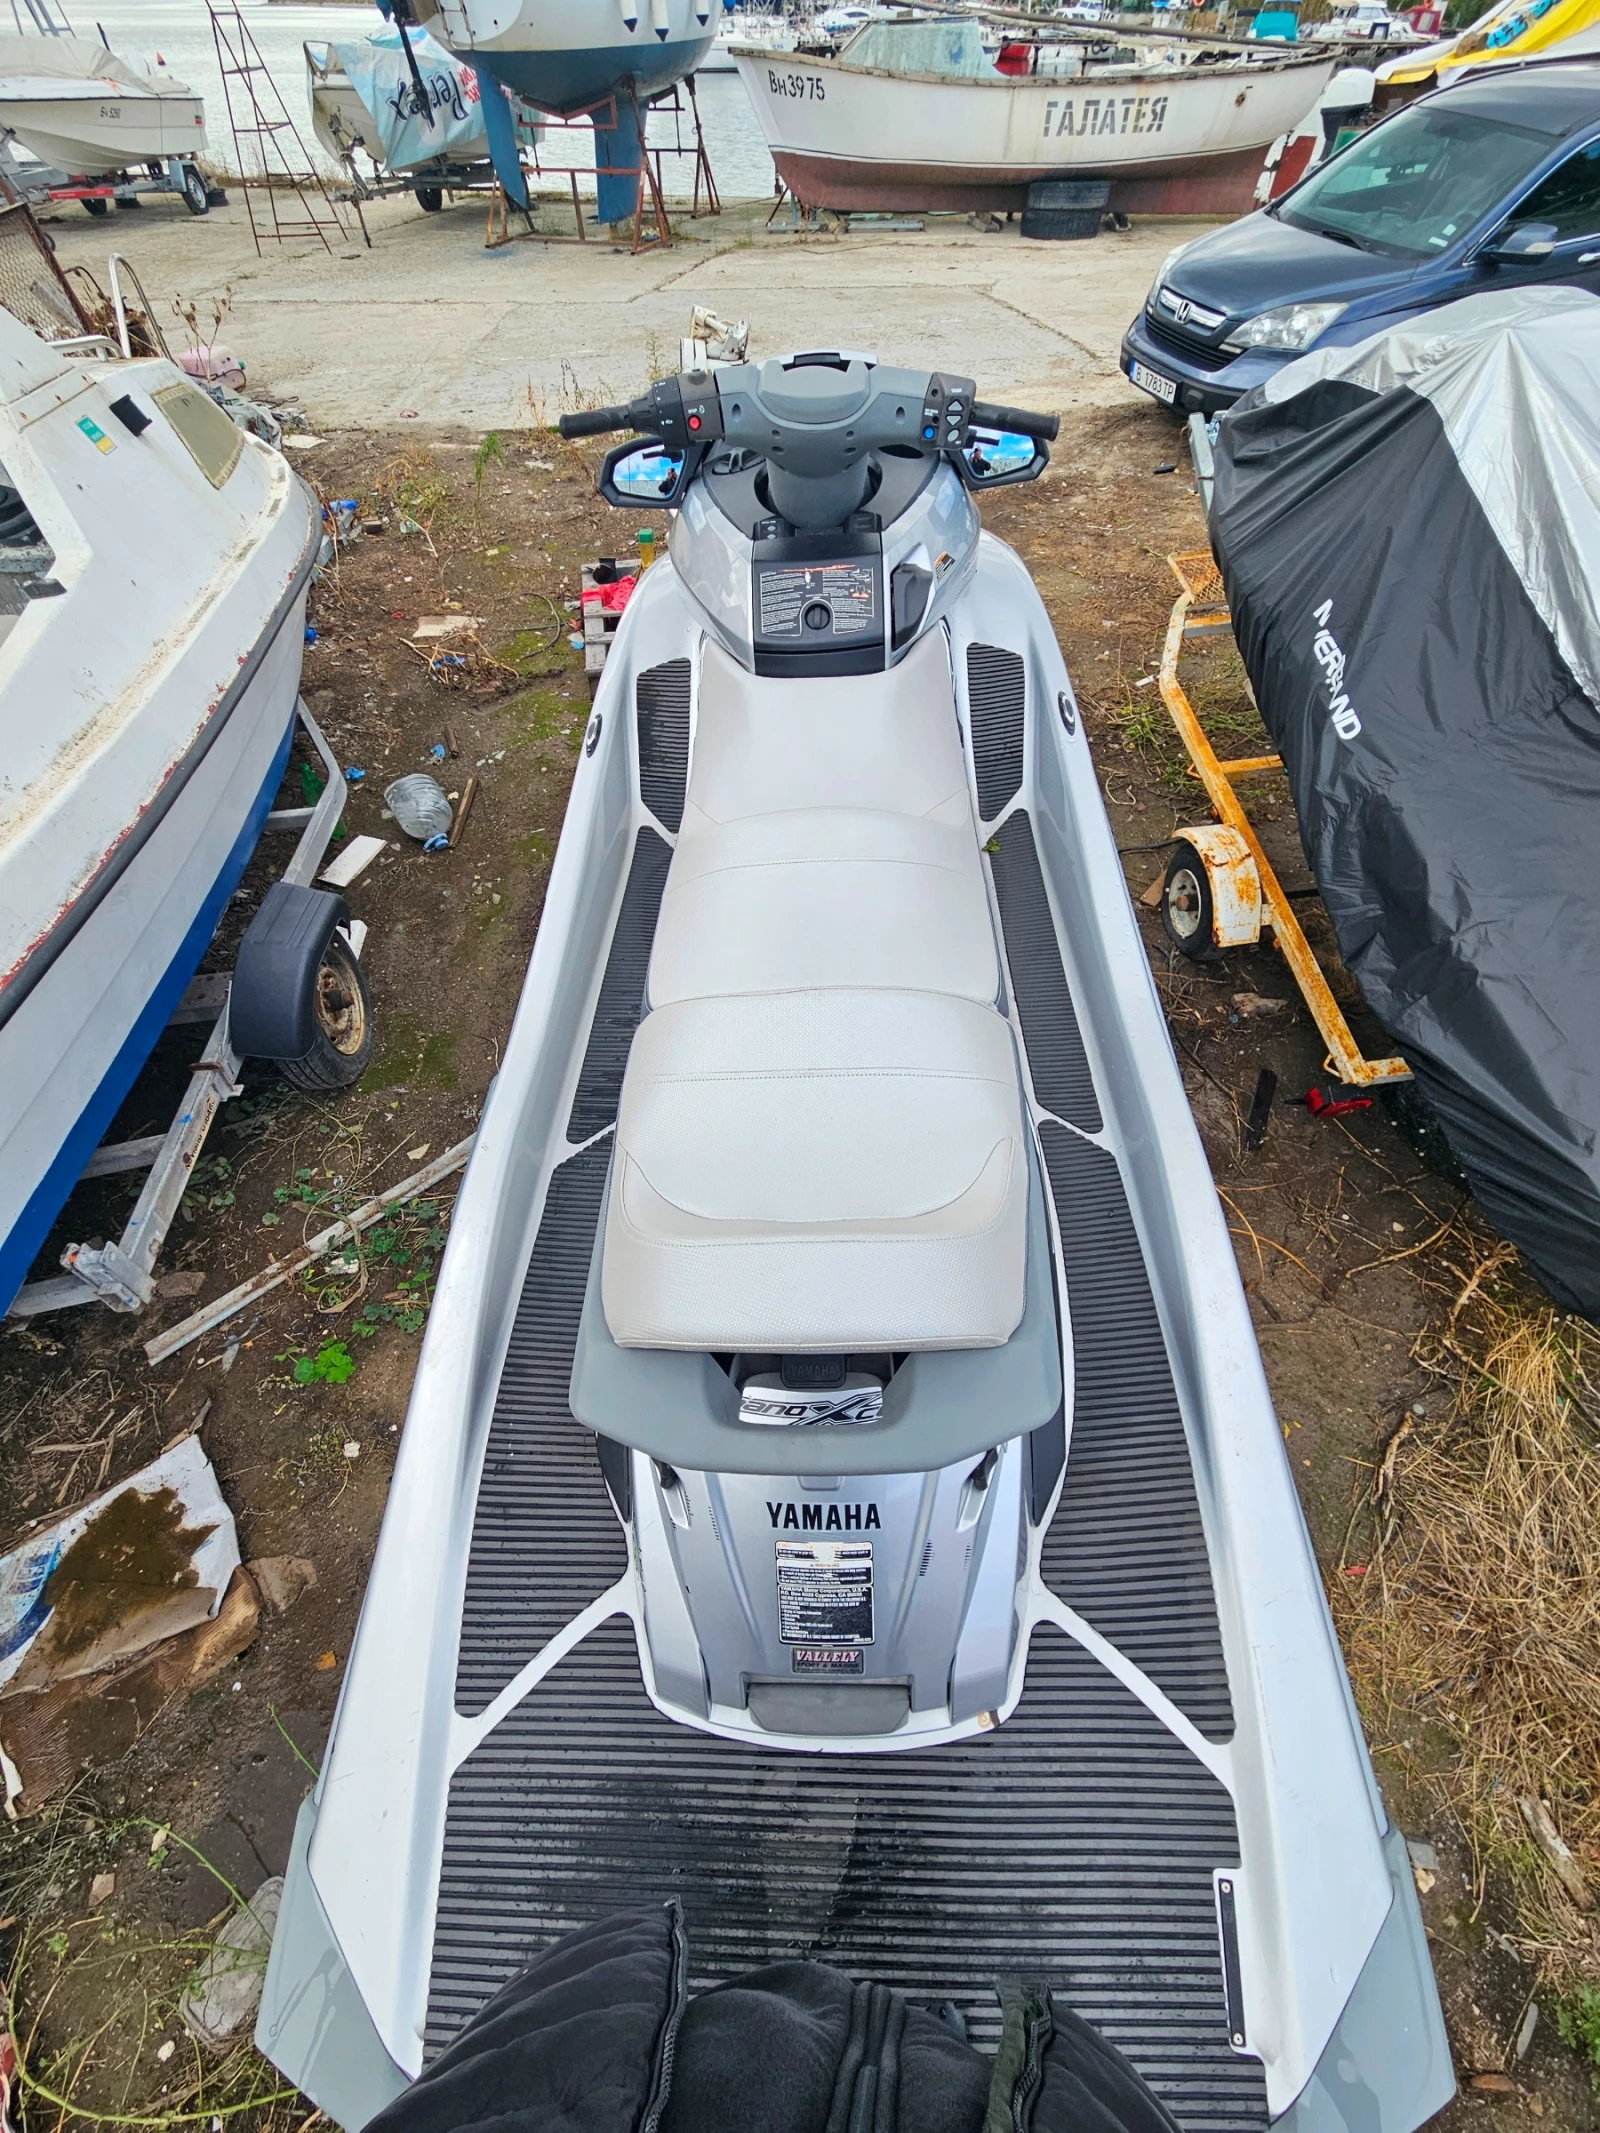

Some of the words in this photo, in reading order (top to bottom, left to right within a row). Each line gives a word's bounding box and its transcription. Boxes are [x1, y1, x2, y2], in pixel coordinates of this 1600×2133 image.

[1043, 96, 1169, 137] ГАЛАТЕЯ
[791, 1364, 837, 1377] YAMAHA
[766, 1501, 881, 1531] YAMAHA
[796, 1650, 859, 1662] VALLELY
